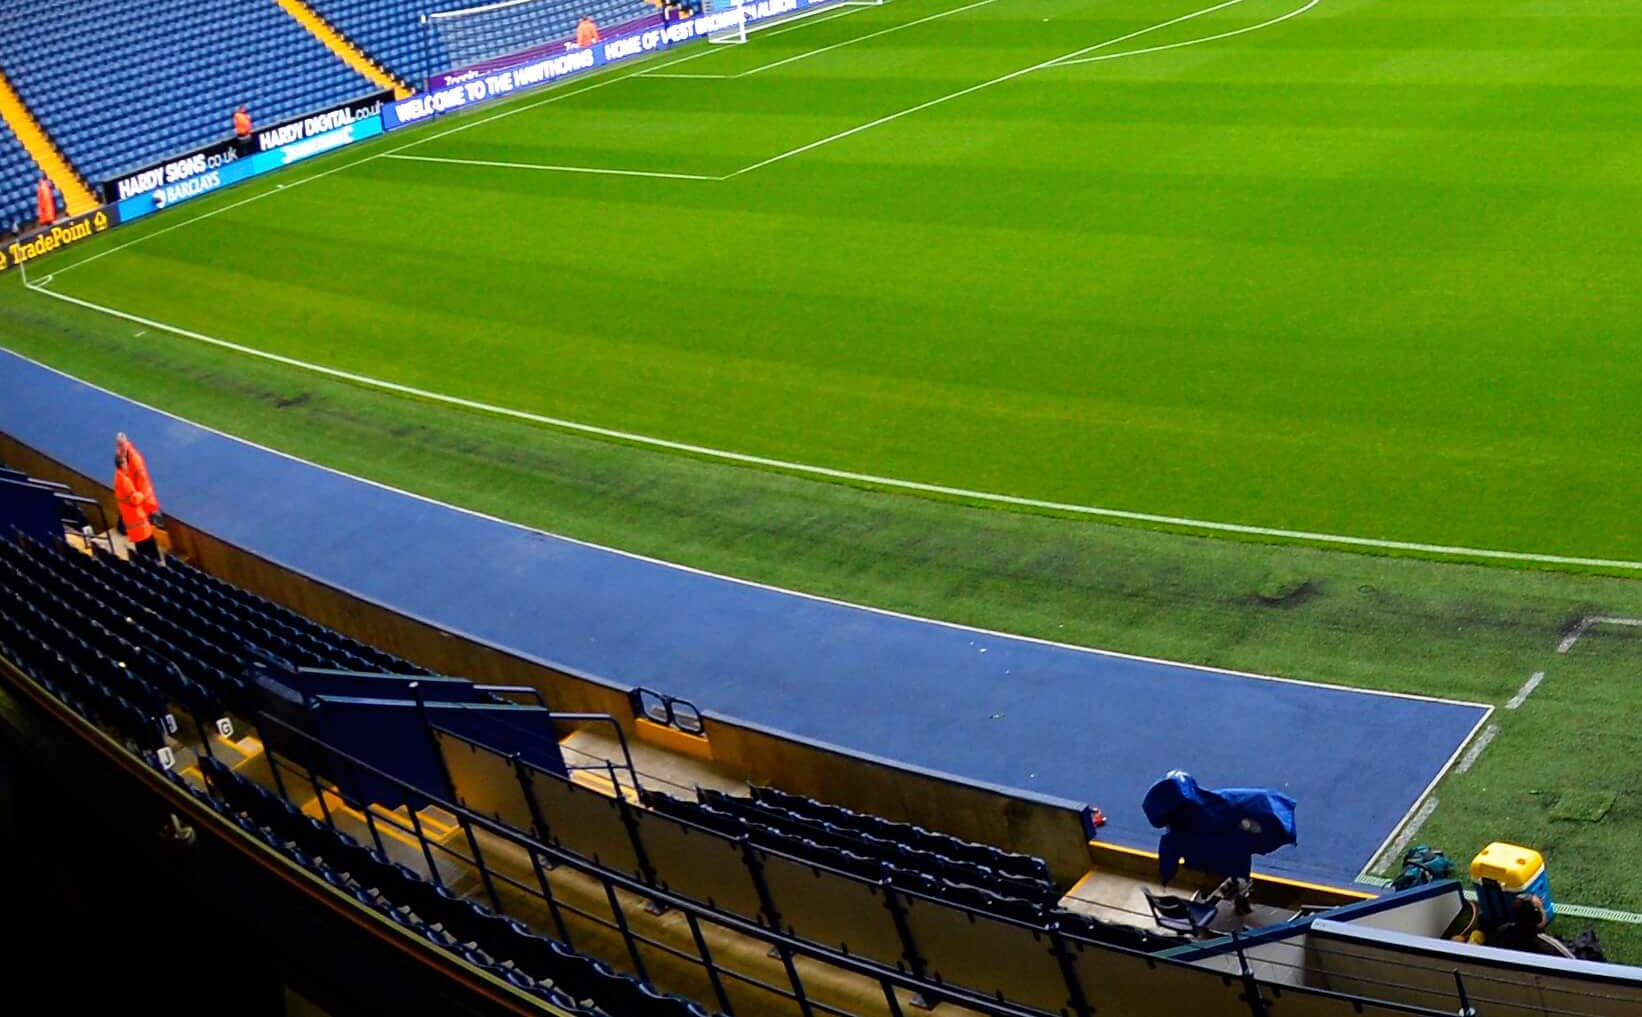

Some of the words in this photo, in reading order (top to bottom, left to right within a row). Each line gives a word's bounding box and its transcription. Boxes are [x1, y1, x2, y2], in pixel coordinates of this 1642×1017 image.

[604, 34, 642, 60] HOME
[642, 28, 660, 50] OF
[660, 20, 694, 45] WEST
[395, 87, 466, 122] WELCOME
[466, 80, 486, 101] TO
[487, 72, 513, 95] THE
[513, 49, 594, 84] HAWTHORNS
[259, 125, 304, 152] HARDY
[118, 168, 165, 200] HARDY
[166, 171, 221, 203] BARCLAYS
[9, 217, 92, 264] TradePoint
